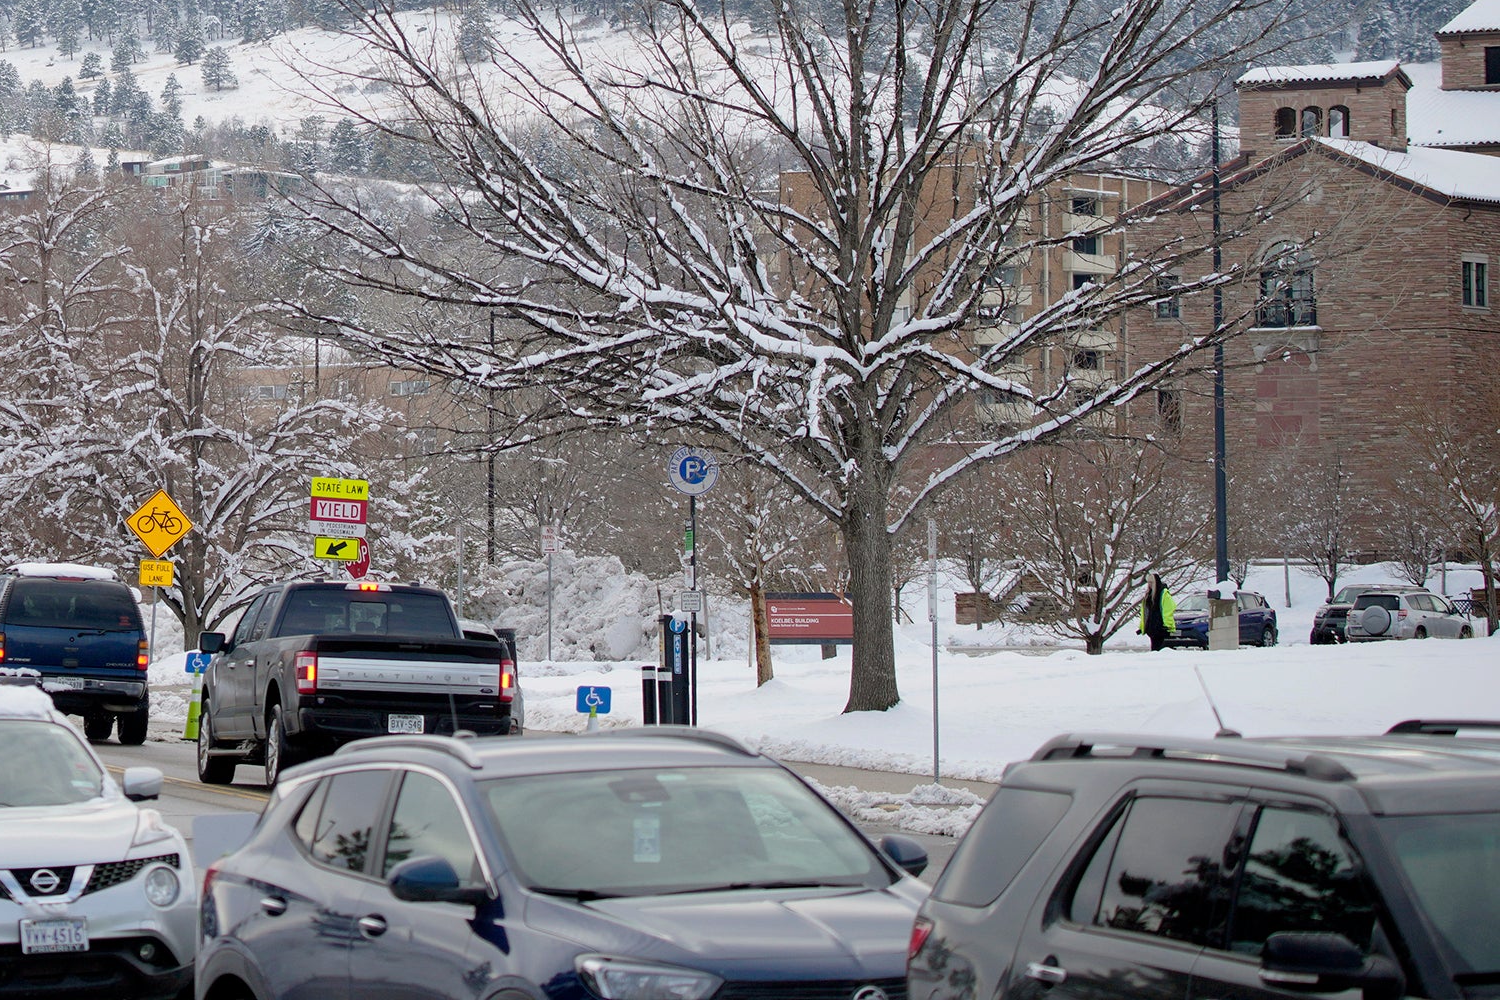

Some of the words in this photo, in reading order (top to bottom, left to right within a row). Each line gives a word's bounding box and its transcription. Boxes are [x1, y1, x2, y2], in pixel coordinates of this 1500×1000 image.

[685, 460, 701, 480] P
[316, 482, 341, 493] STATE
[346, 485, 364, 494] LAW
[319, 501, 359, 518] YIELD
[326, 522, 358, 531] PEDESTRIANS
[156, 564, 170, 572] FULL
[674, 620, 681, 631] P
[347, 671, 471, 683] PLATINUM
[390, 719, 422, 730] BXV-S46
